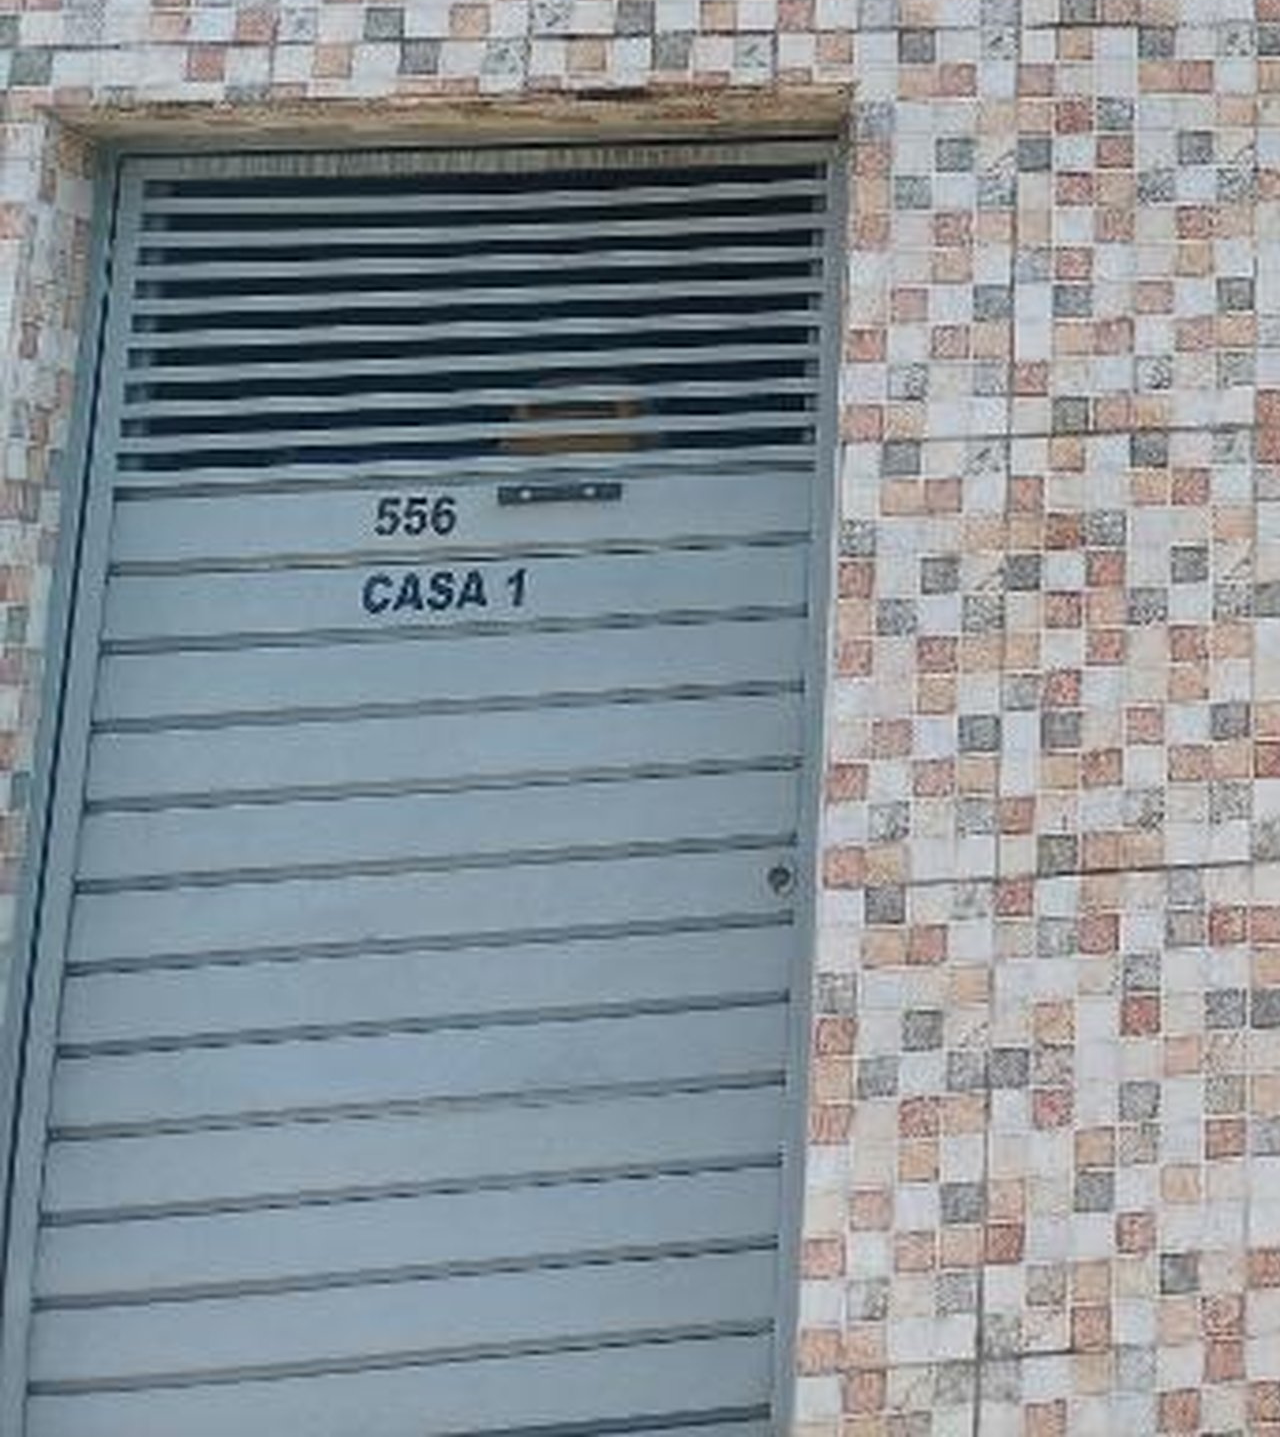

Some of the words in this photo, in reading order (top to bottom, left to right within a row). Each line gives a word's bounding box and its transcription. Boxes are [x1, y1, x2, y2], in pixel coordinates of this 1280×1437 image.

[374, 495, 457, 536] 556
[362, 569, 488, 614] CASA
[507, 568, 527, 608] 1
